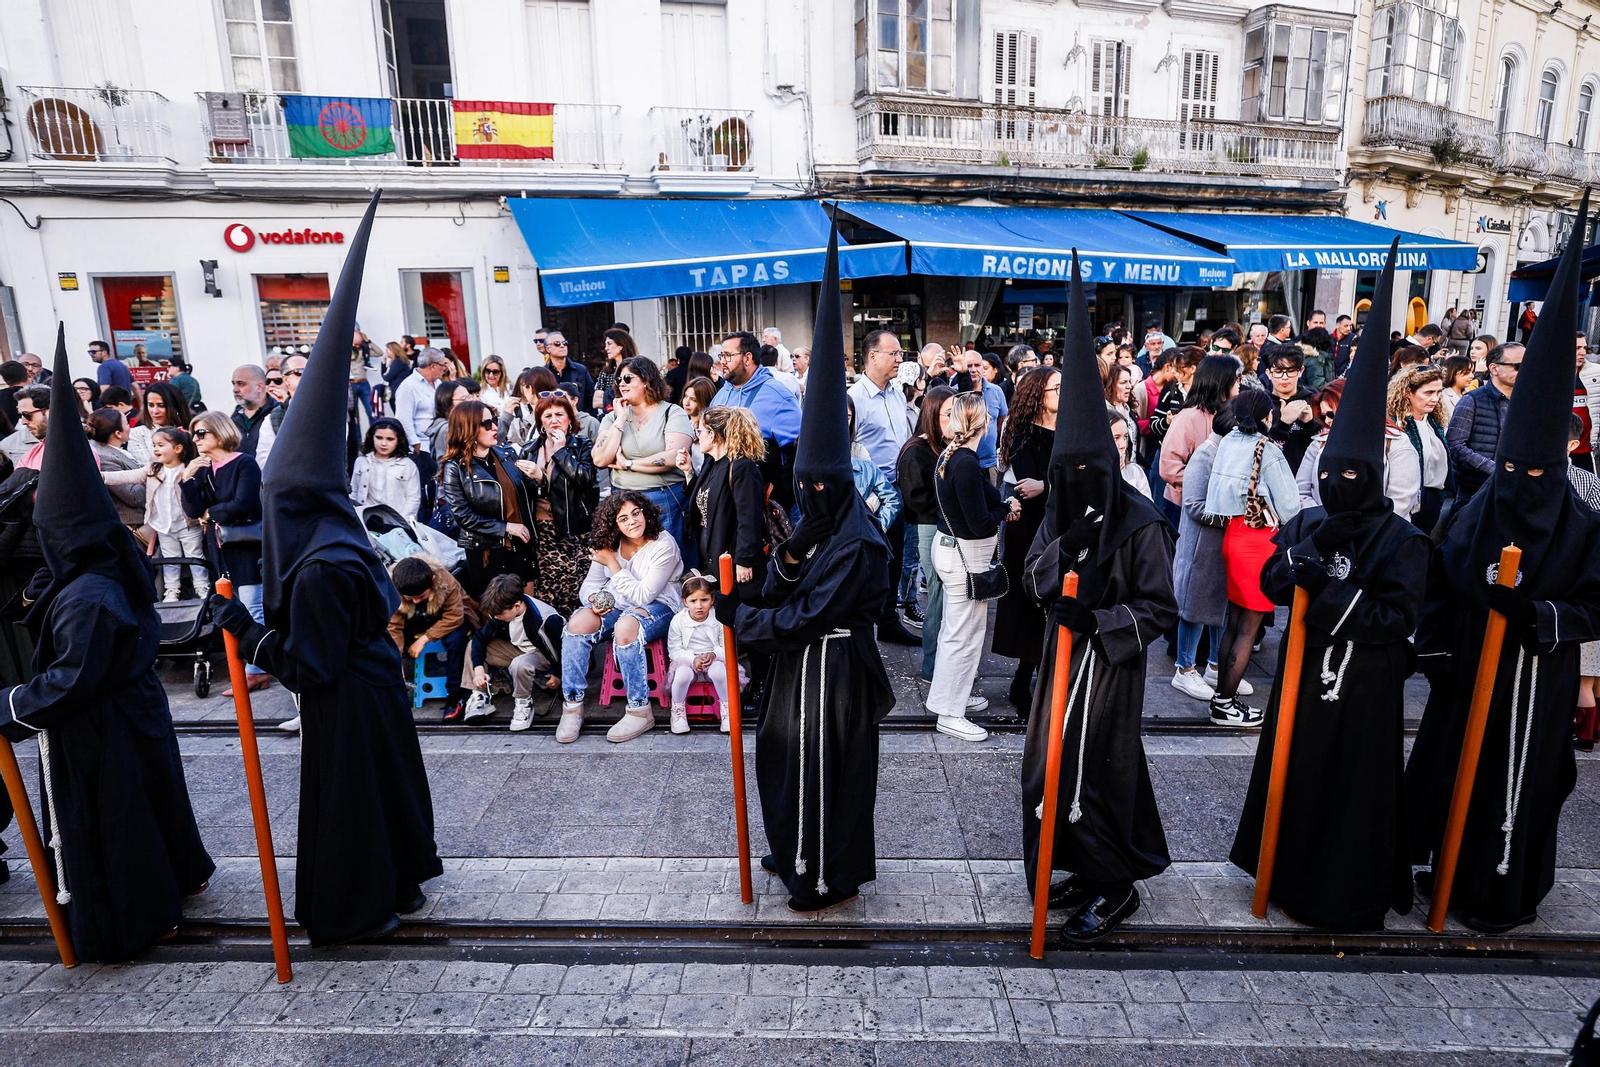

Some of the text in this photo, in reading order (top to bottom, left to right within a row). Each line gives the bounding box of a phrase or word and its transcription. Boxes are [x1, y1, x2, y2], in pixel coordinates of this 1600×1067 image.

[258, 228, 344, 245] vodafone
[1285, 252, 1311, 267] LA
[689, 260, 790, 288] TAPAS
[1102, 261, 1117, 278] Y
[1124, 262, 1181, 282] MENÚ
[1199, 267, 1227, 279] Mahou
[559, 280, 606, 294] Mahou
